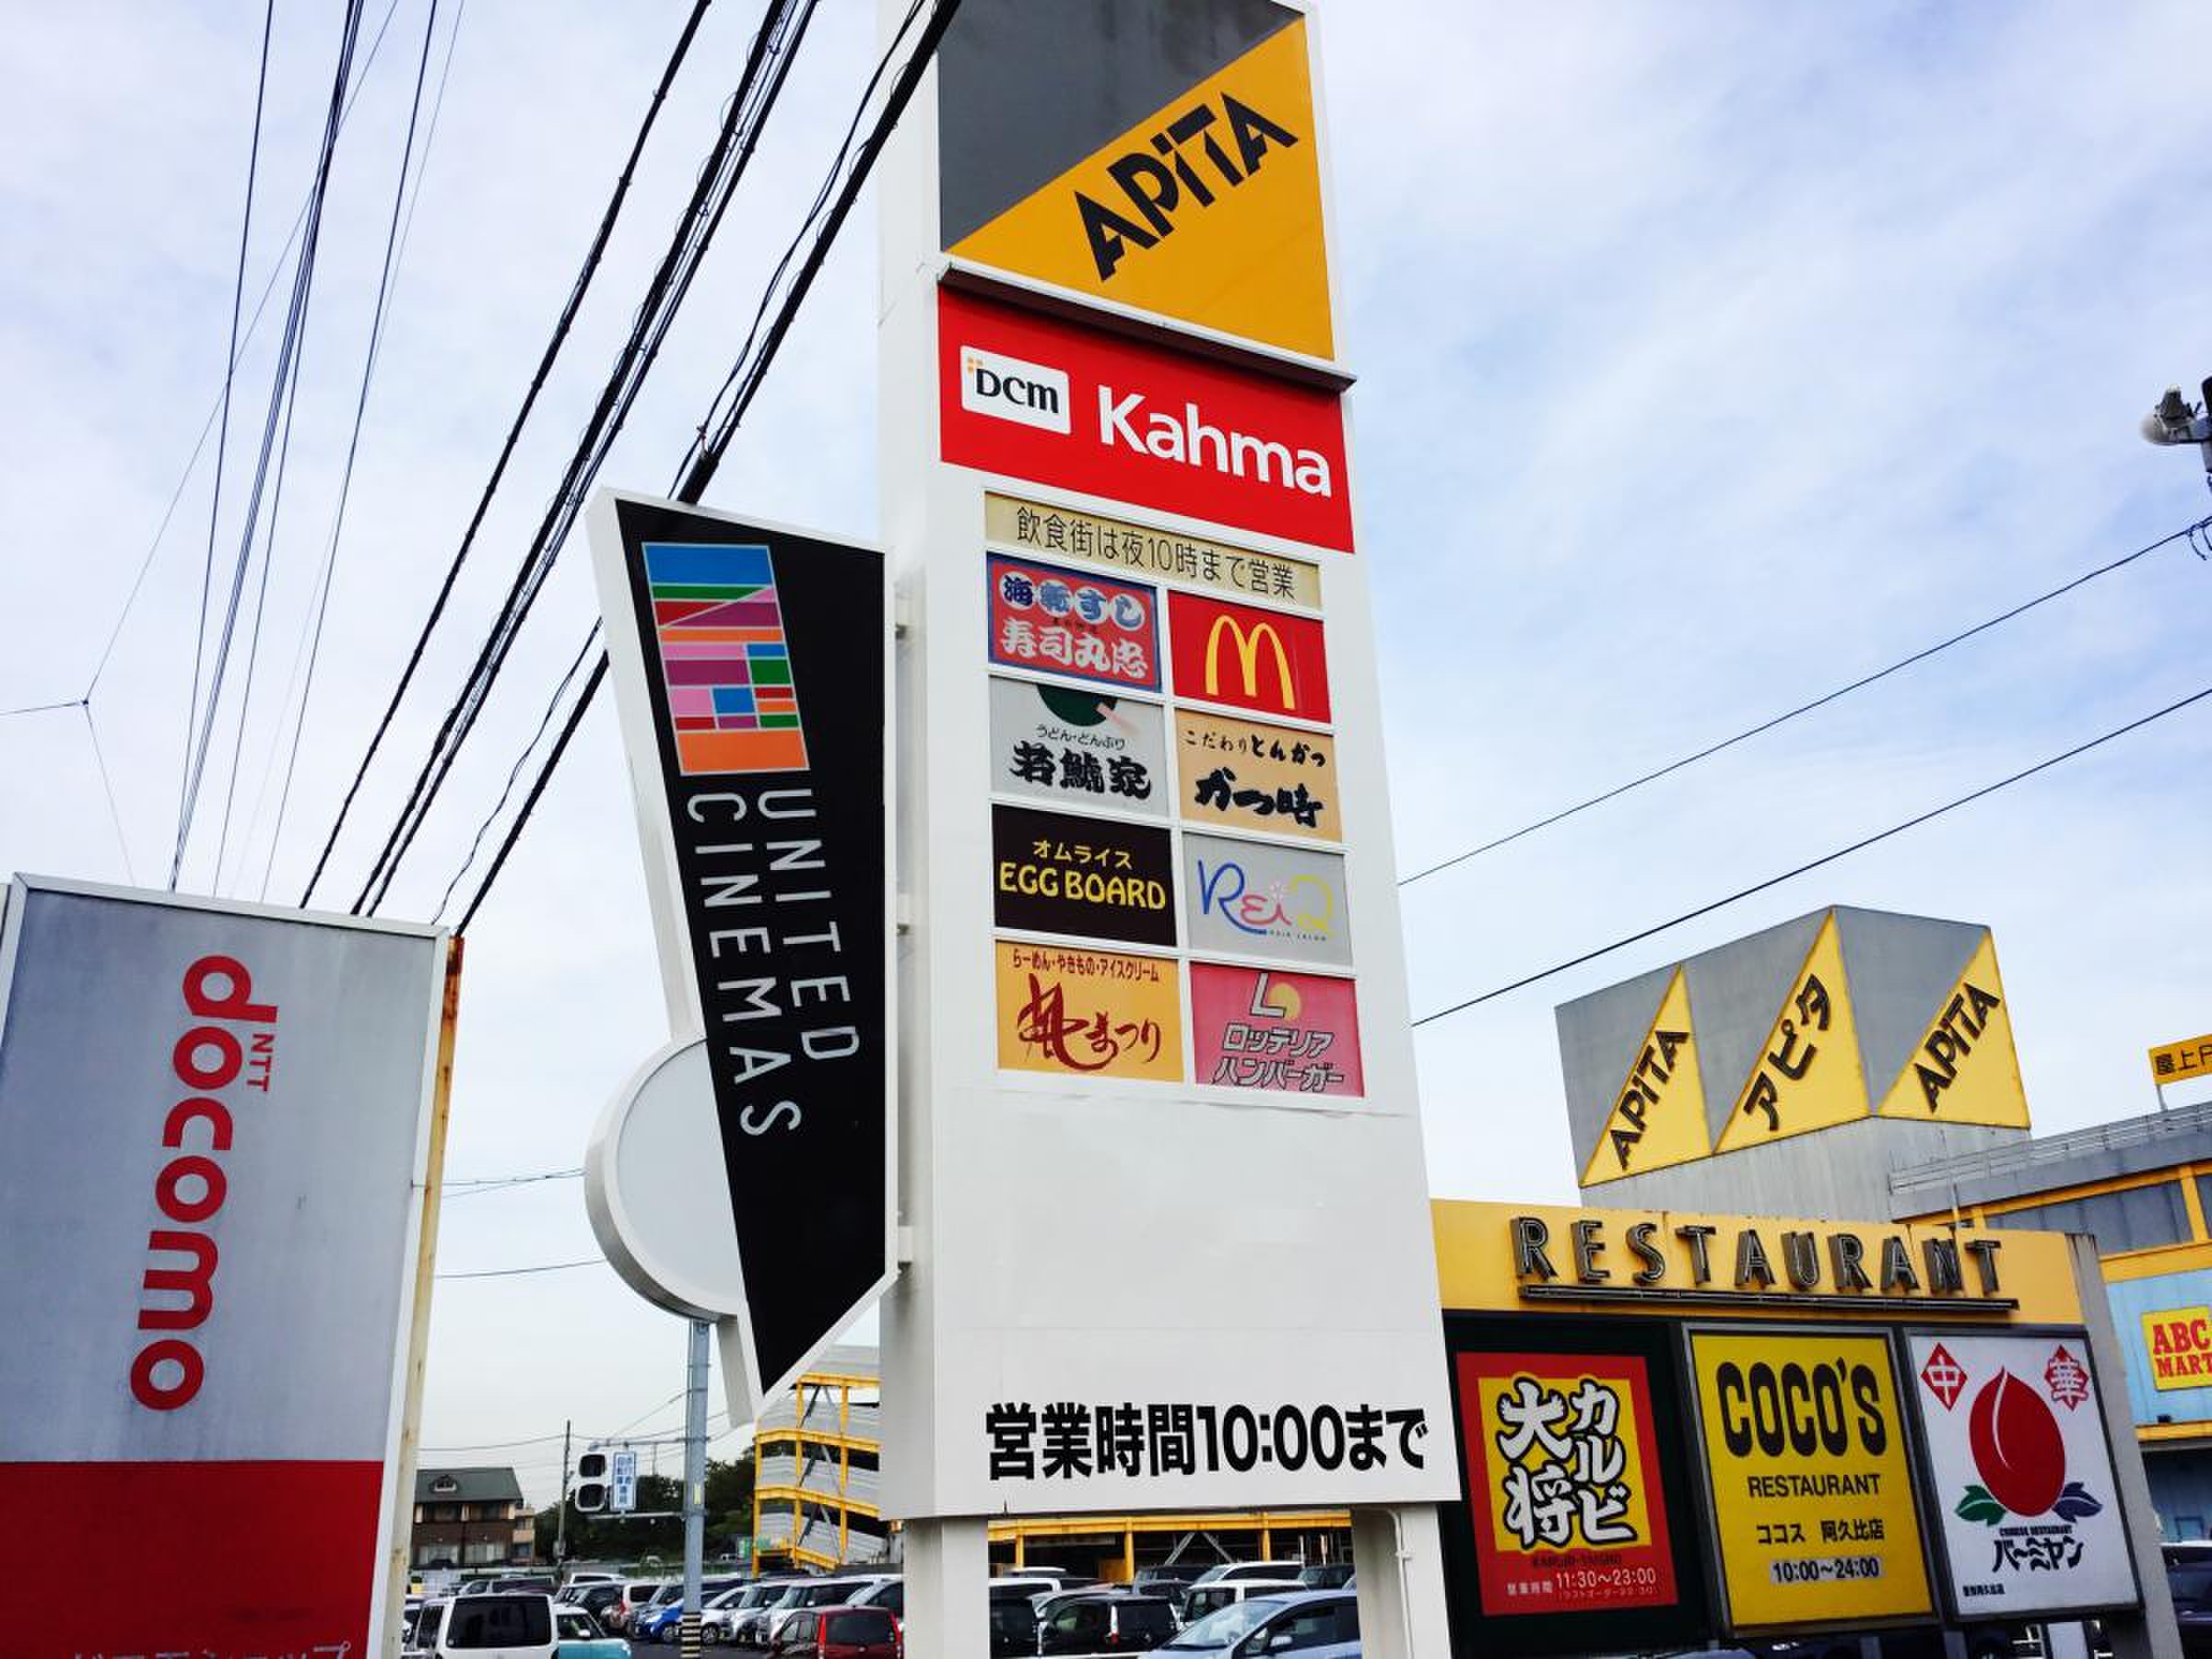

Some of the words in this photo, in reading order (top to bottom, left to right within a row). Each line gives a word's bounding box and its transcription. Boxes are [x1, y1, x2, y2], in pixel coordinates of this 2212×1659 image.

[1098, 384, 1333, 499] Kahma
[1017, 506, 1297, 605] 飲食街は夜10時まで営業
[999, 861, 1059, 897] EGG
[1065, 869, 1166, 910] BOARD
[1032, 840, 1133, 870] オムライス
[687, 792, 803, 1136] CINEMAS
[759, 788, 861, 1062] UNITED
[246, 1033, 275, 1092] NTT
[1211, 1056, 1345, 1093] ハンバーガー
[1222, 1022, 1335, 1059] ロッテリア
[1744, 973, 1831, 1131] アピタ
[1912, 982, 2001, 1113] APITA
[1607, 1028, 1690, 1171] APITA
[130, 955, 278, 1412] docomo
[1510, 1216, 2001, 1294] RESTAURANT
[2152, 1319, 2211, 1355] ABC
[985, 1402, 1430, 1481] 営業時間10:00まで
[1716, 1357, 1887, 1457] COCO'S
[1747, 1474, 1881, 1498] RESTAURANT
[1756, 1523, 1806, 1545] ココス
[1991, 1535, 2084, 1574] バーミヤン
